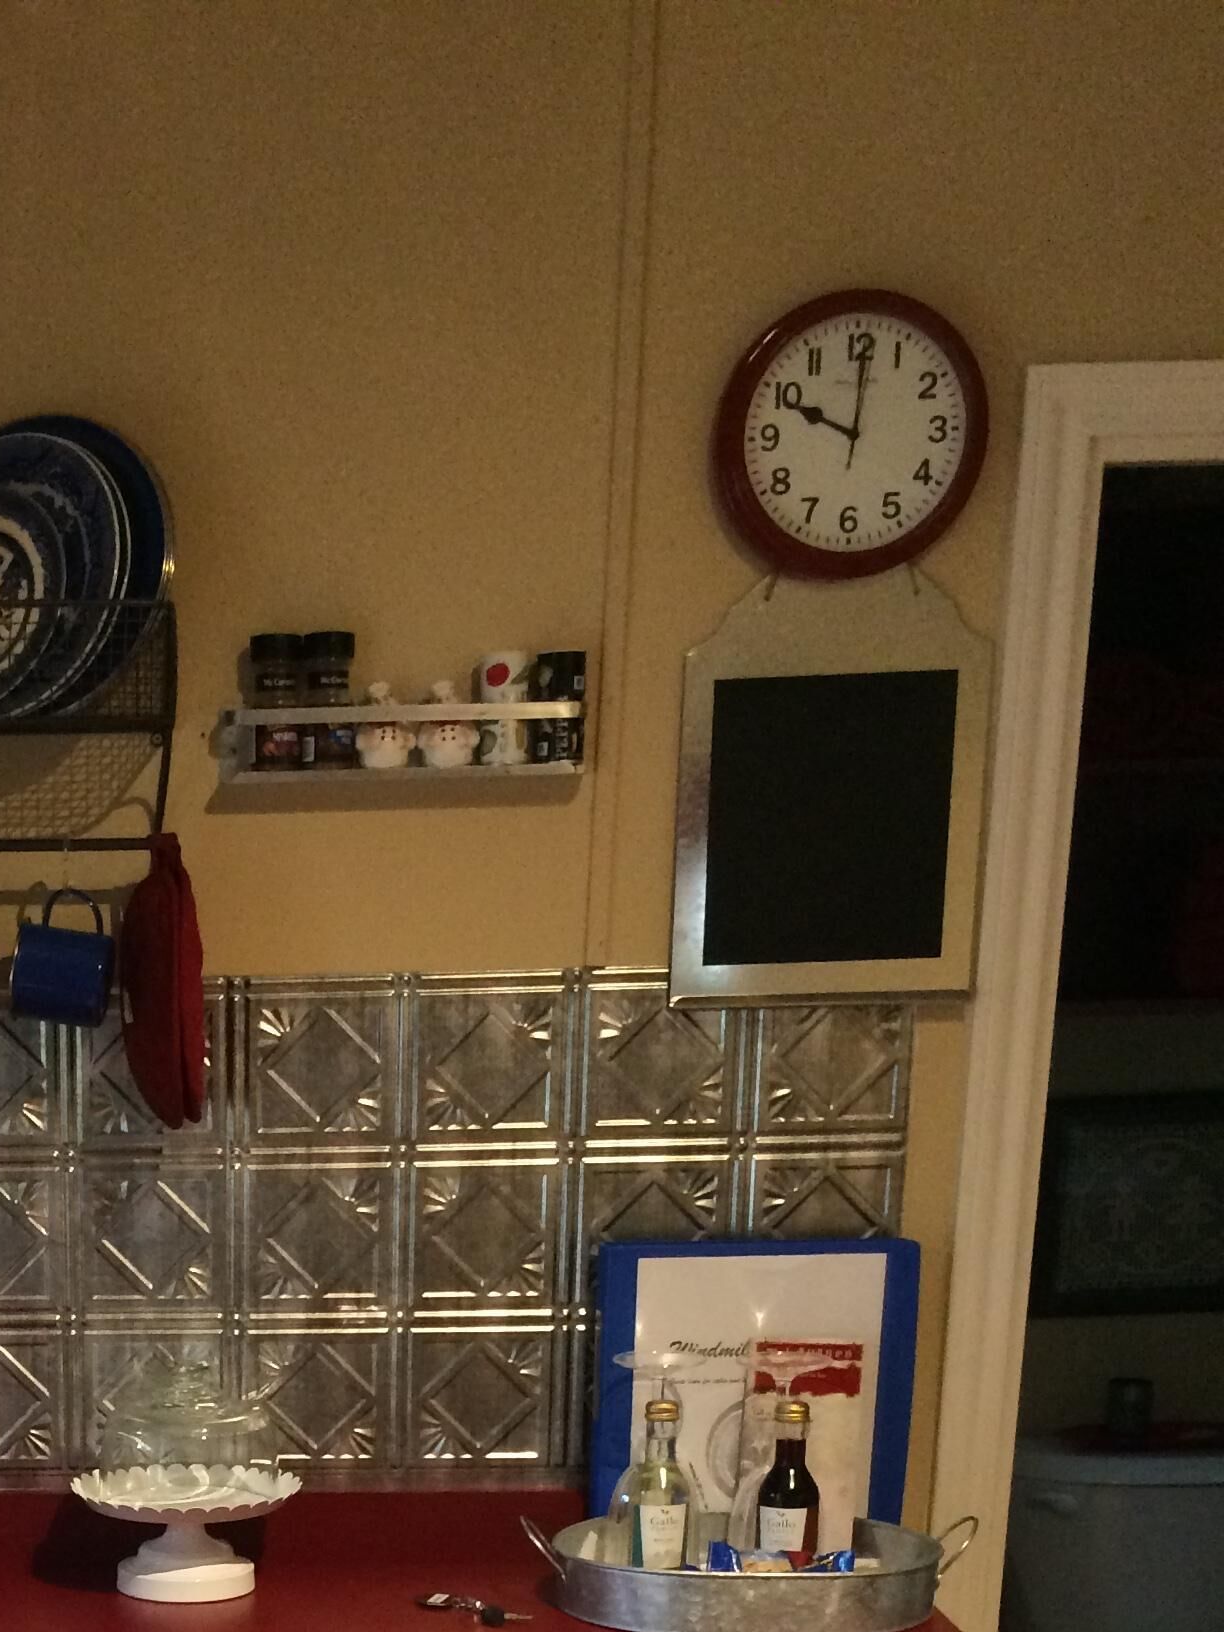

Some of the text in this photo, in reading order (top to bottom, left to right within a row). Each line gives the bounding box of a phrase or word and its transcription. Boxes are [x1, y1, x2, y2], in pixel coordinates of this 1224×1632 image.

[807, 347, 822, 377] 11
[848, 333, 876, 362] 12
[894, 341, 902, 369] 1
[775, 381, 803, 410] 10
[918, 371, 939, 400] 2
[760, 423, 780, 452] 9
[927, 415, 948, 444] 3
[770, 467, 791, 496] 8
[912, 458, 933, 486] 4
[800, 496, 820, 524] 7
[838, 505, 858, 534] 6
[881, 491, 902, 520] 5
